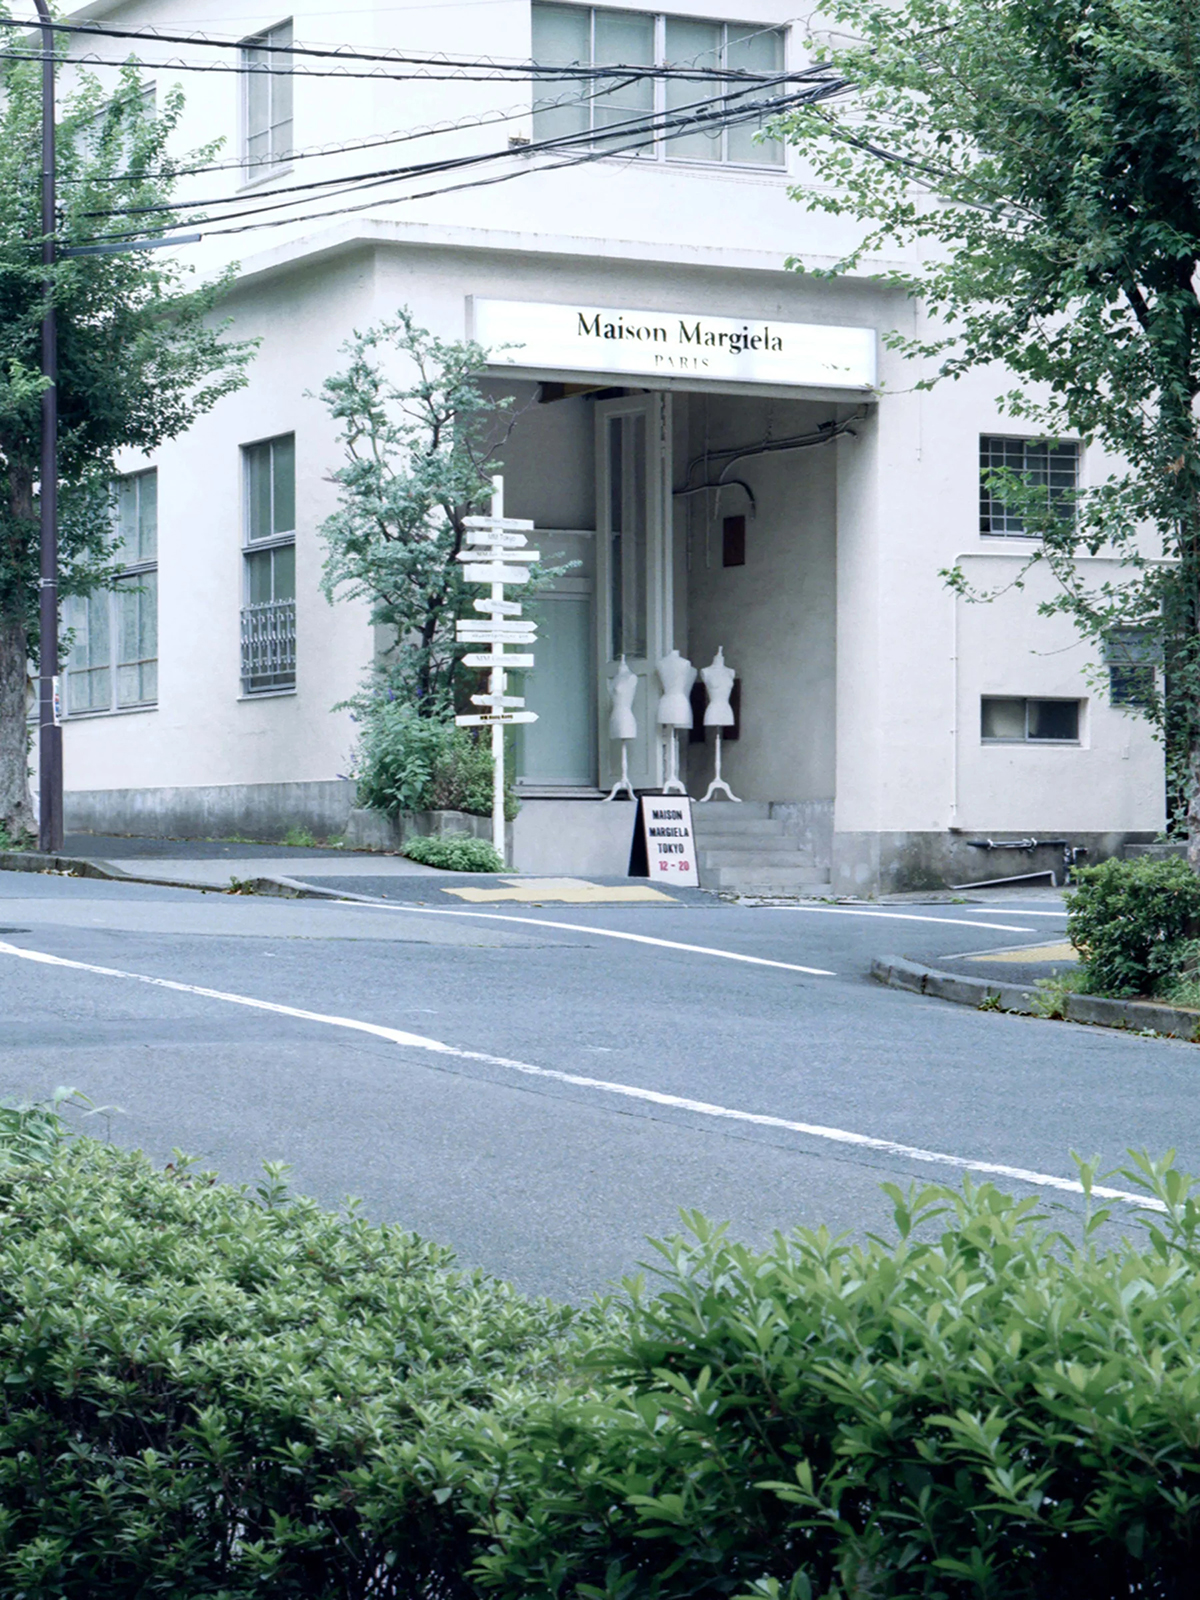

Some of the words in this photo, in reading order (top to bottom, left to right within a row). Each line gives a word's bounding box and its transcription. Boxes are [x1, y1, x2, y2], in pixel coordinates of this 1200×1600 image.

[577, 312, 668, 344] Maison
[678, 320, 784, 355] Margiela
[654, 354, 710, 370] PARIS
[652, 809, 683, 820] MAISON
[648, 827, 690, 837] MARGIELA
[657, 843, 685, 854] TOKYO
[658, 860, 669, 871] 12
[678, 860, 690, 871] 20
